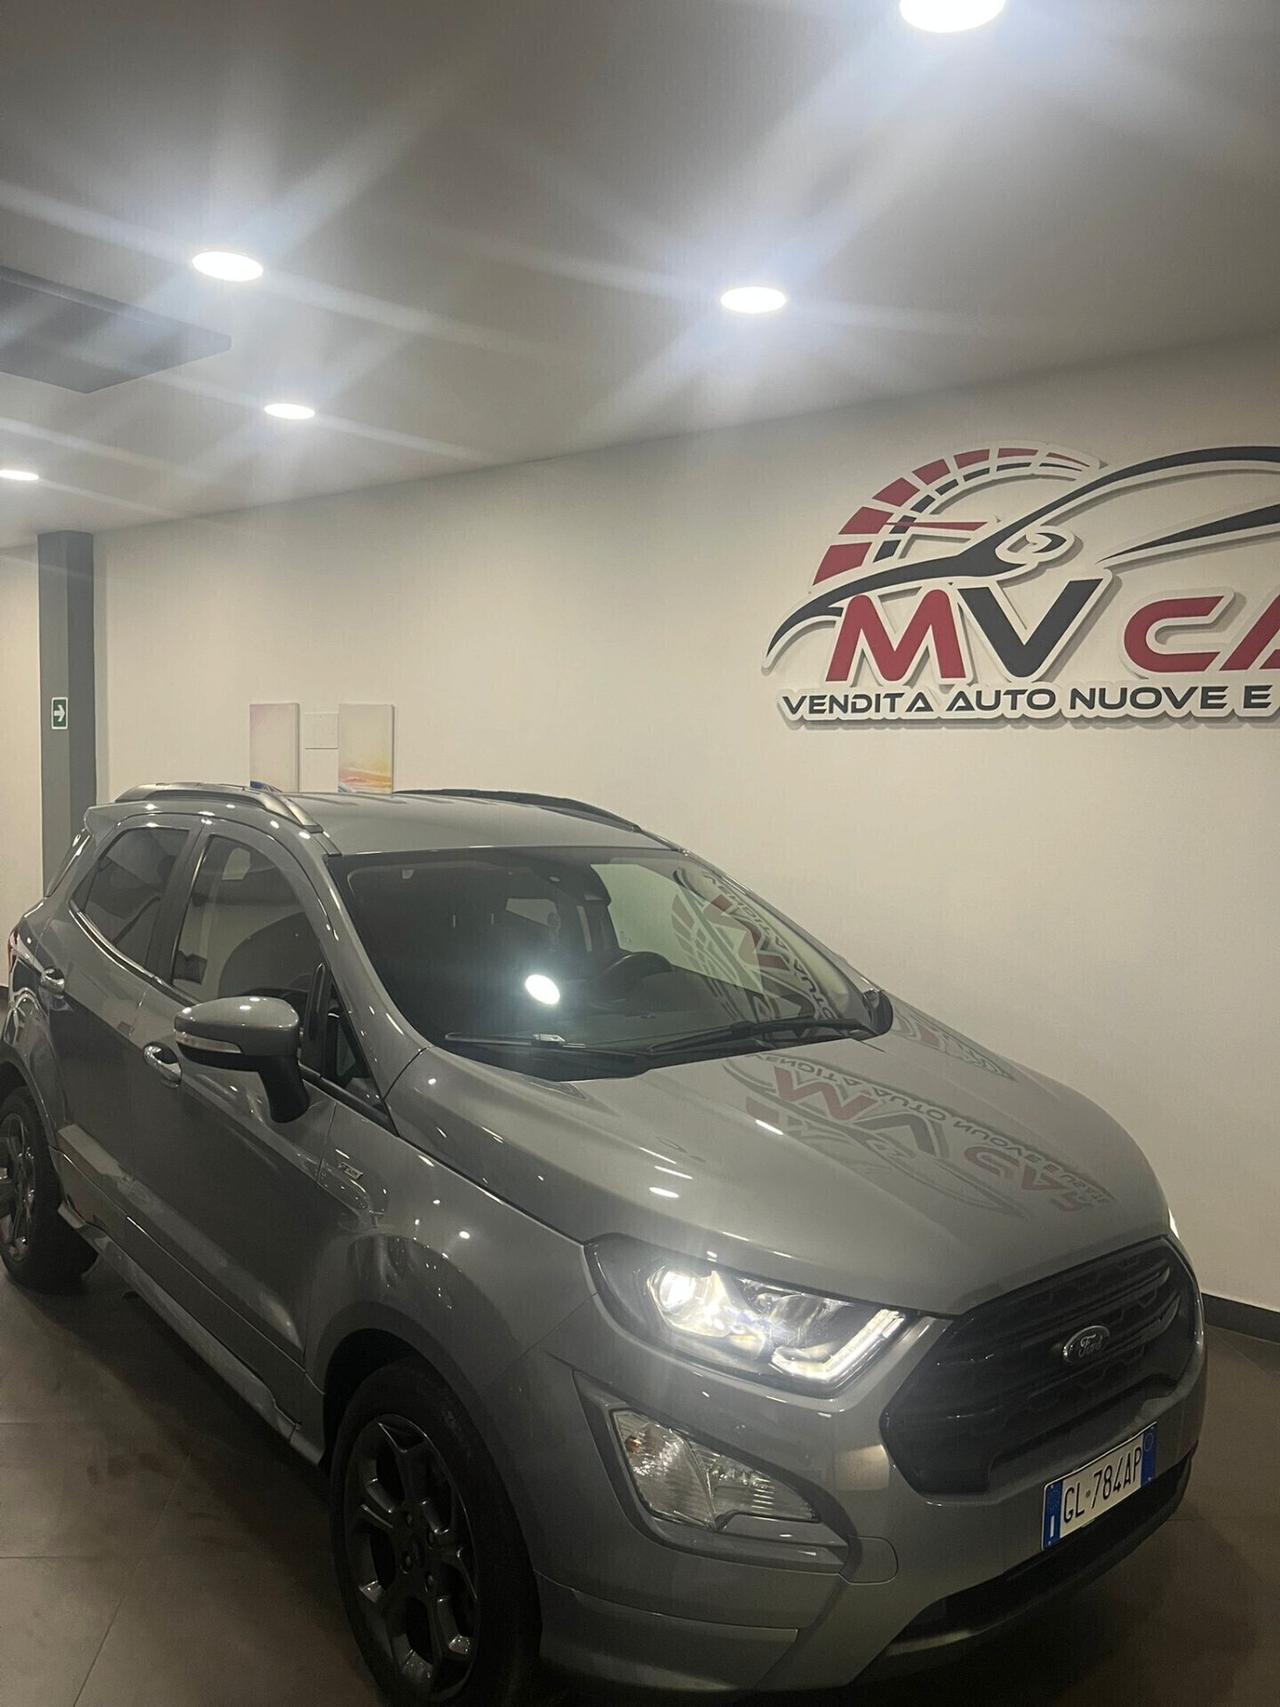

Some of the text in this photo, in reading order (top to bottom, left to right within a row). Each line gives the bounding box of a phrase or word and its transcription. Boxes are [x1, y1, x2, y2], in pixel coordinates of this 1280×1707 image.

[825, 578, 1104, 682] MV
[782, 685, 1273, 715] VENDITA AUTO NUOVE E
